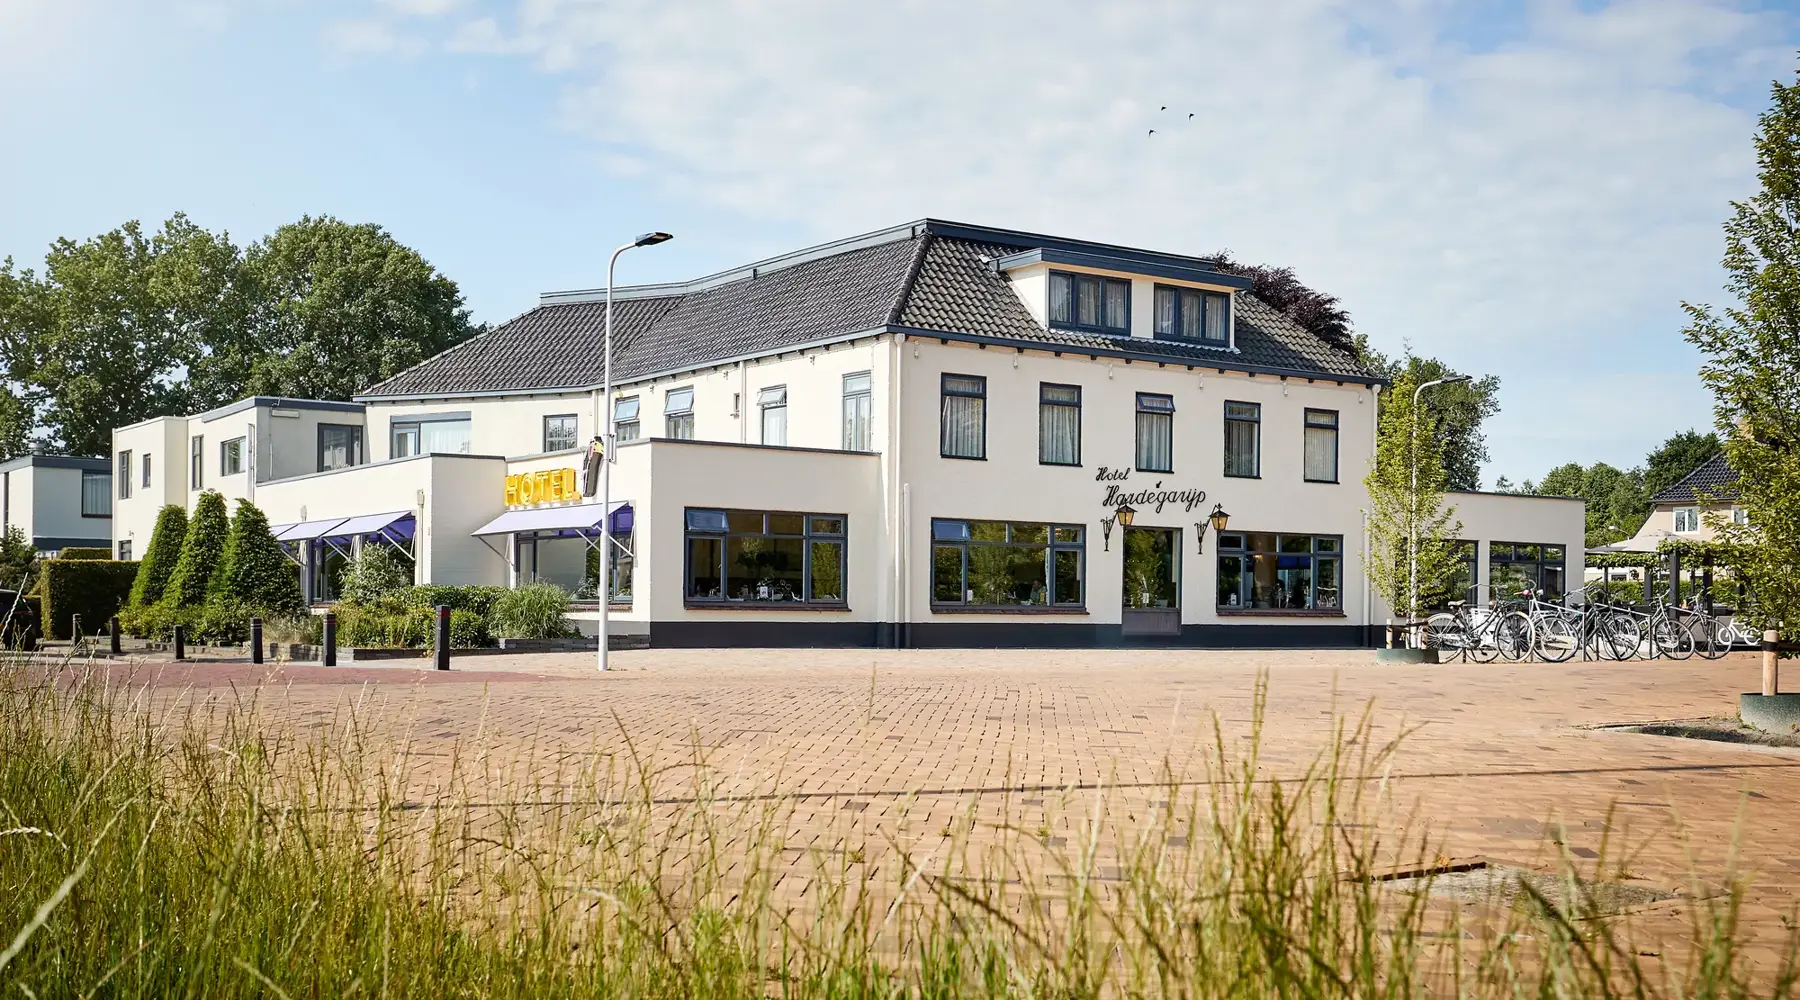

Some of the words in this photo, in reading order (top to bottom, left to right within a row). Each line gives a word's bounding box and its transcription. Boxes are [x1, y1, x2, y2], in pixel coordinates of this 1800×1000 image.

[505, 468, 576, 506] HOTEL
[1095, 466, 1131, 482] Hotel
[1102, 484, 1206, 514] Hardegarijp
